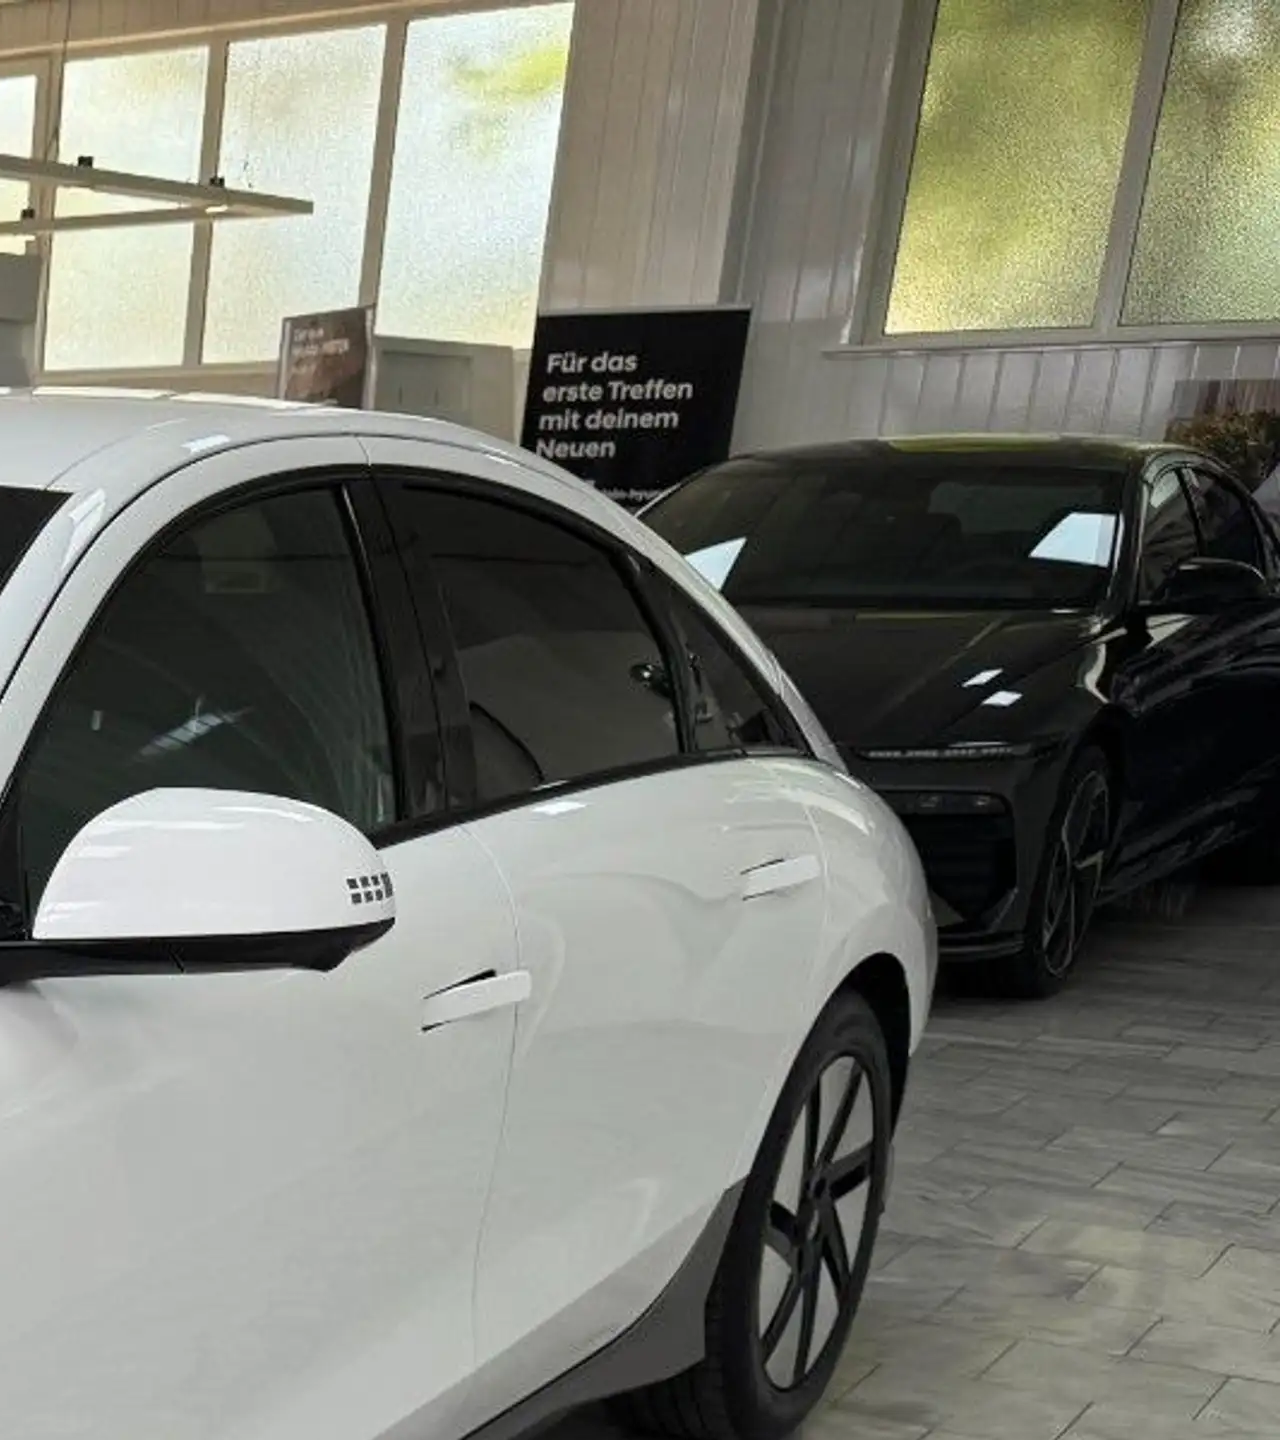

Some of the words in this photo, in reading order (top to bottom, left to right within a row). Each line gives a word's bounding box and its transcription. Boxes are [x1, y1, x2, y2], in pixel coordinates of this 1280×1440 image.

[546, 351, 587, 374] Für
[591, 351, 638, 373] das
[542, 382, 604, 402] erste
[607, 379, 693, 401] Treffen
[539, 409, 581, 431] mit
[585, 408, 679, 431] deinem
[535, 439, 616, 459] Neuen
